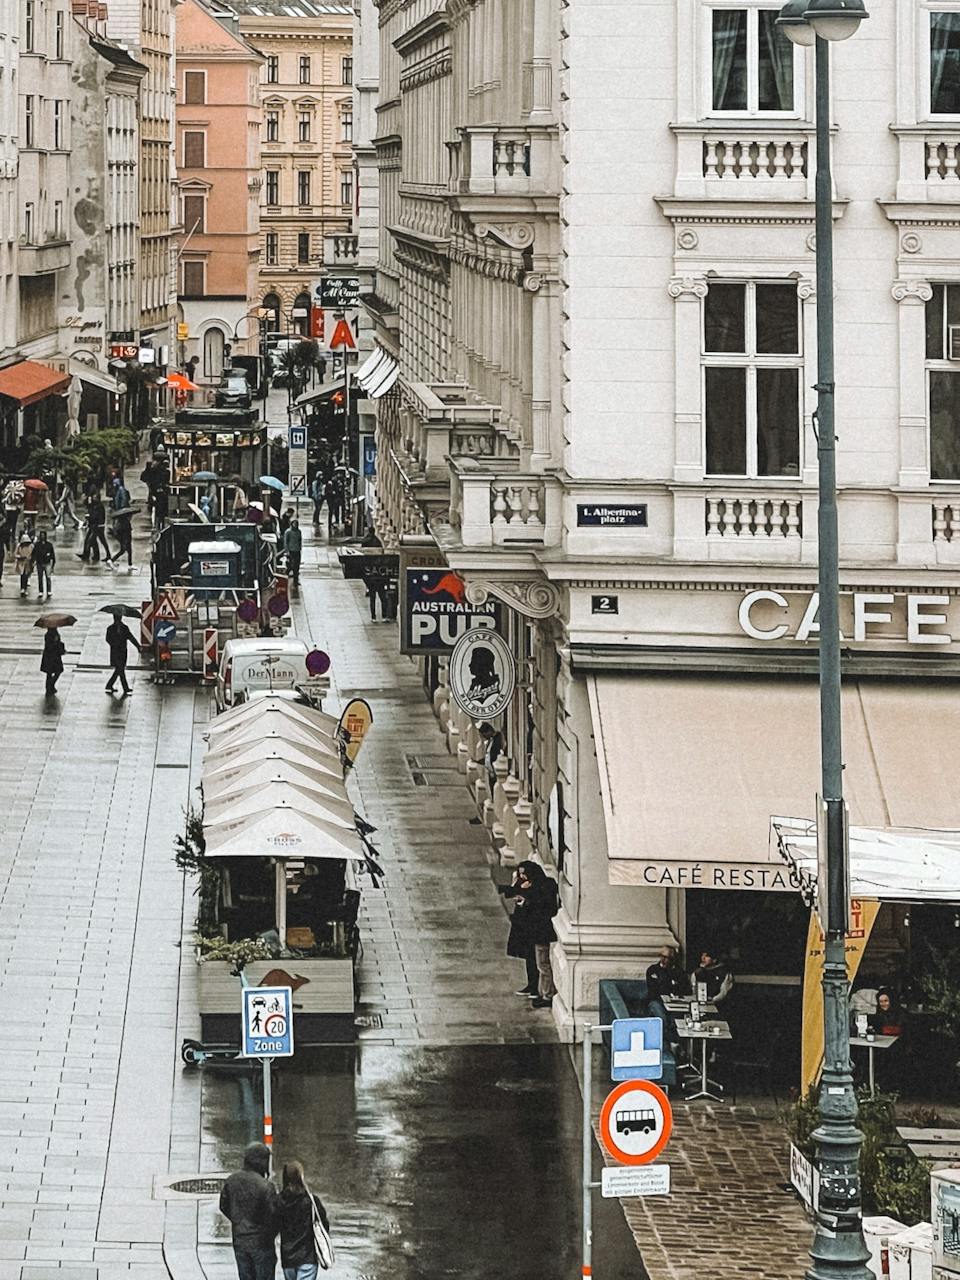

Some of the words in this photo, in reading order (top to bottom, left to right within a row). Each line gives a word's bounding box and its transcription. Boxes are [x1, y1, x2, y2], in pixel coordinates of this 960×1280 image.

[600, 515, 626, 524] platz
[412, 602, 495, 613] AUSTRALIAN
[600, 597, 610, 609] 2
[643, 864, 702, 884] CAFÉ
[271, 1021, 284, 1033] 20
[254, 1039, 283, 1051] Zone
